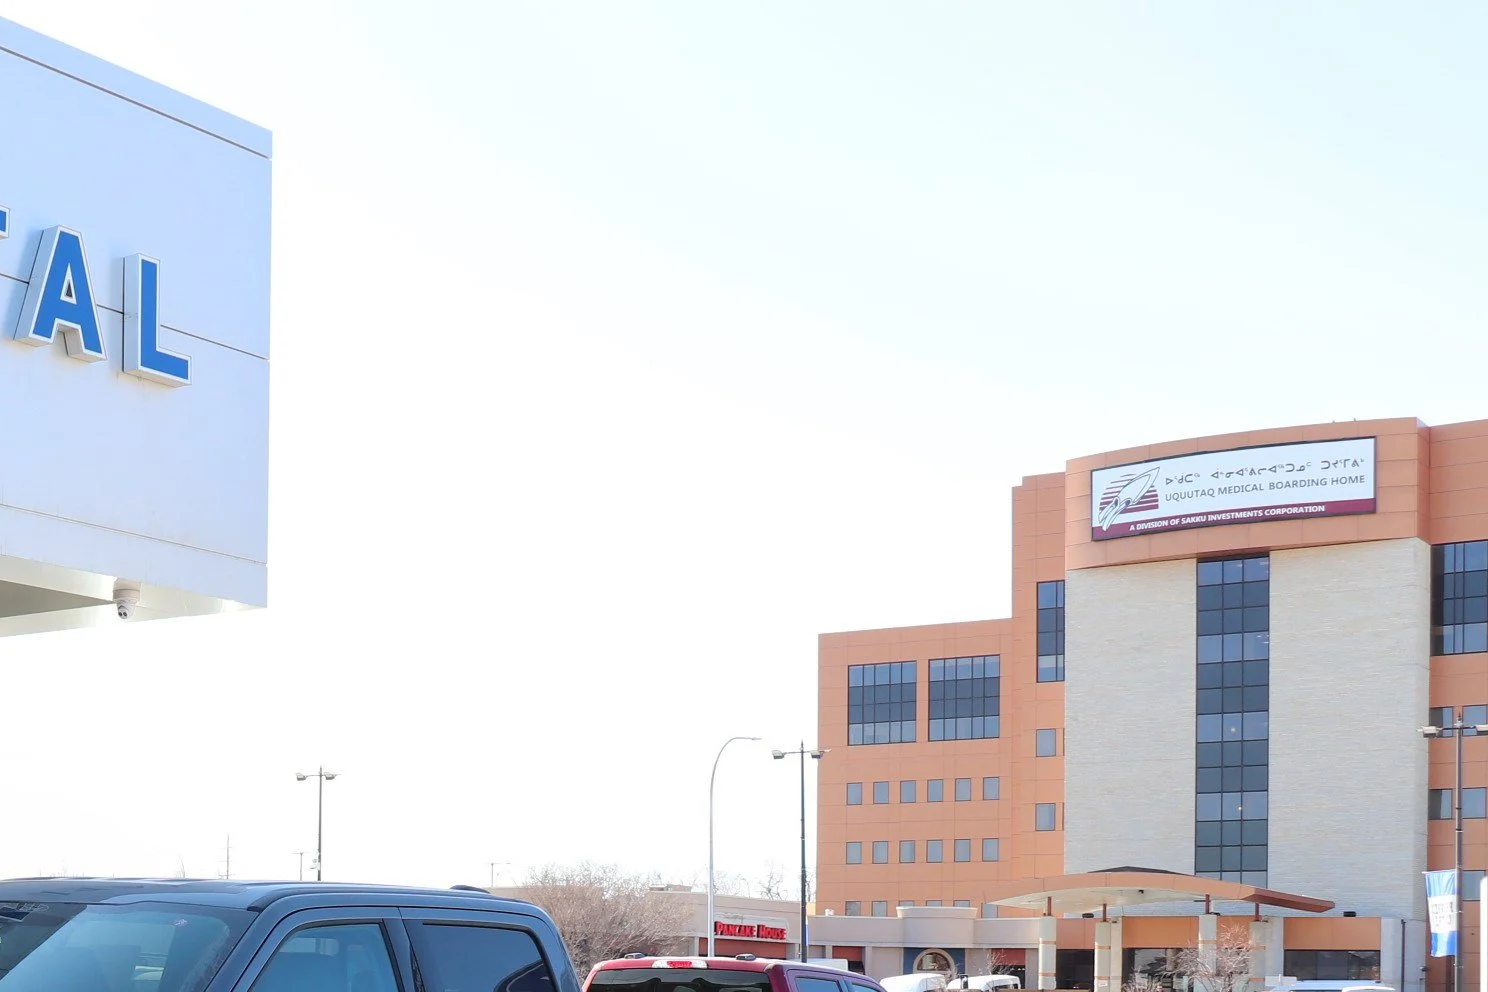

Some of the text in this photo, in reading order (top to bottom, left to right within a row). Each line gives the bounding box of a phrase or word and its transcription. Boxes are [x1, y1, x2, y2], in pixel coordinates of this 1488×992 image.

[1165, 475, 1365, 502] UQUUTAQ MEDICAL BOARDING HOME
[1136, 519, 1168, 530] DIVISION
[1170, 518, 1179, 526] OF
[1181, 514, 1206, 524] SAKKU
[1208, 509, 1263, 521] INVESTMENTS
[1264, 505, 1325, 516] CORPORATION
[714, 921, 787, 940] PANCAKE HOUSE
